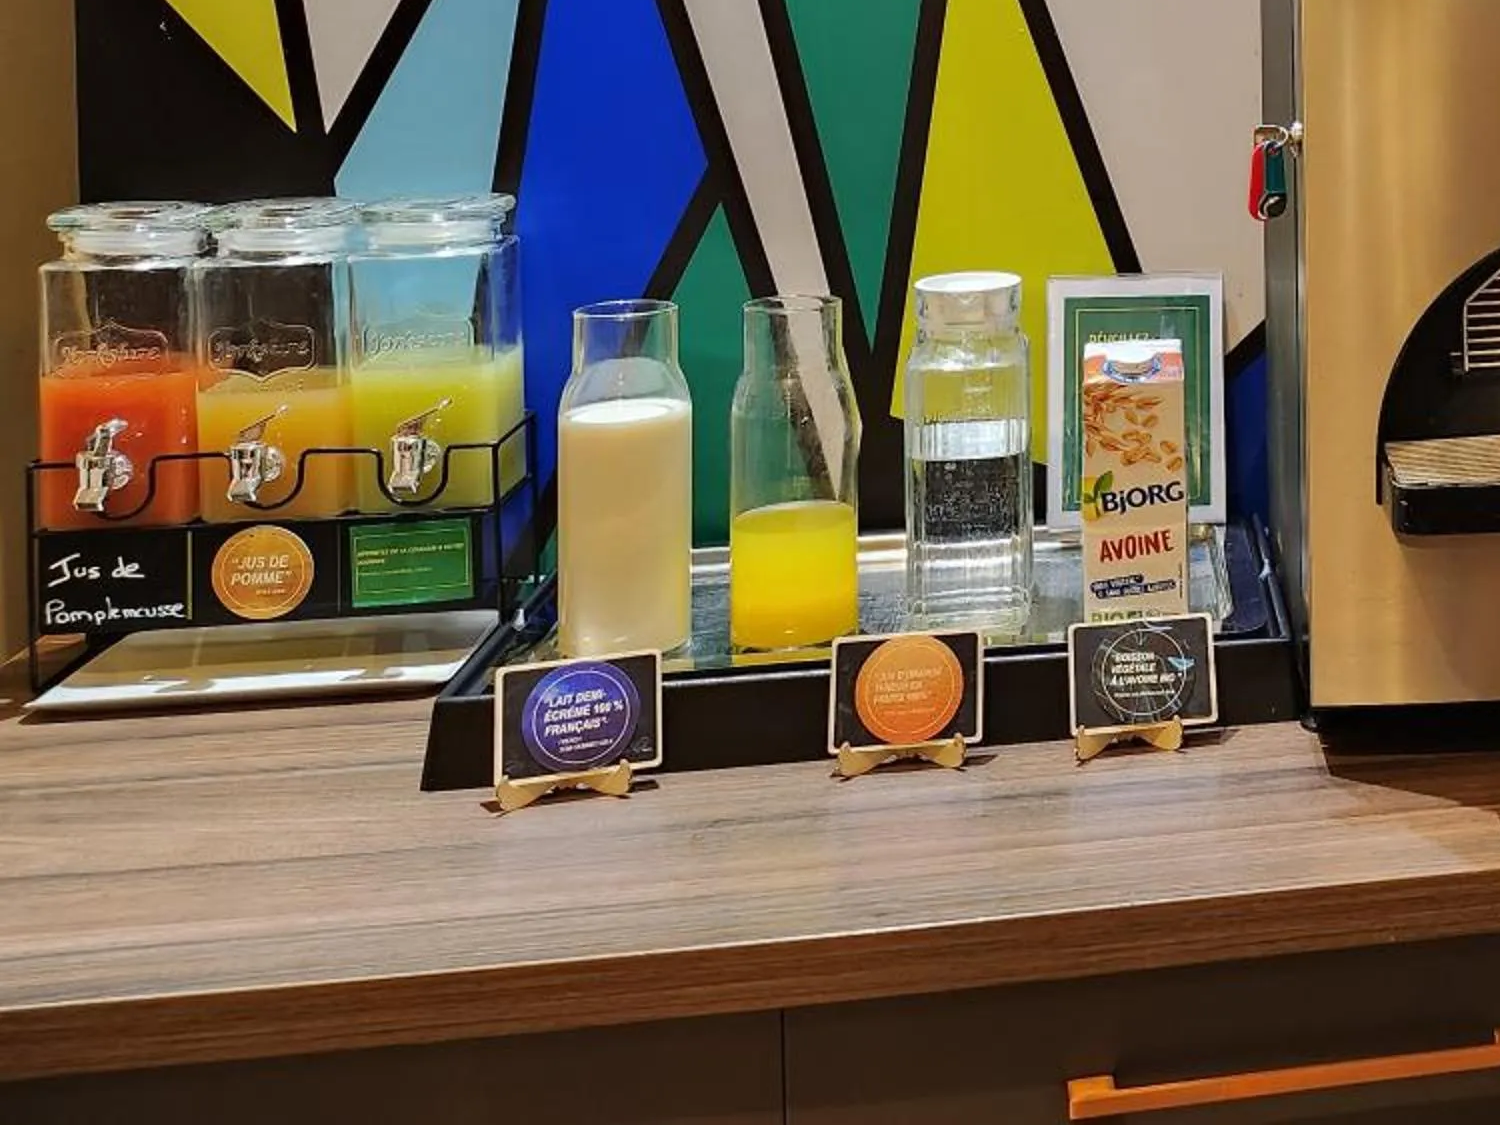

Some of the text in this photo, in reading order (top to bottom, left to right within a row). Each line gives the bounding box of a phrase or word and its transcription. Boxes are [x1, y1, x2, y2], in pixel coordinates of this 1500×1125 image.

[269, 554, 289, 568] DE
[1100, 529, 1175, 563] AVOINE
[48, 552, 145, 588] Jus de
